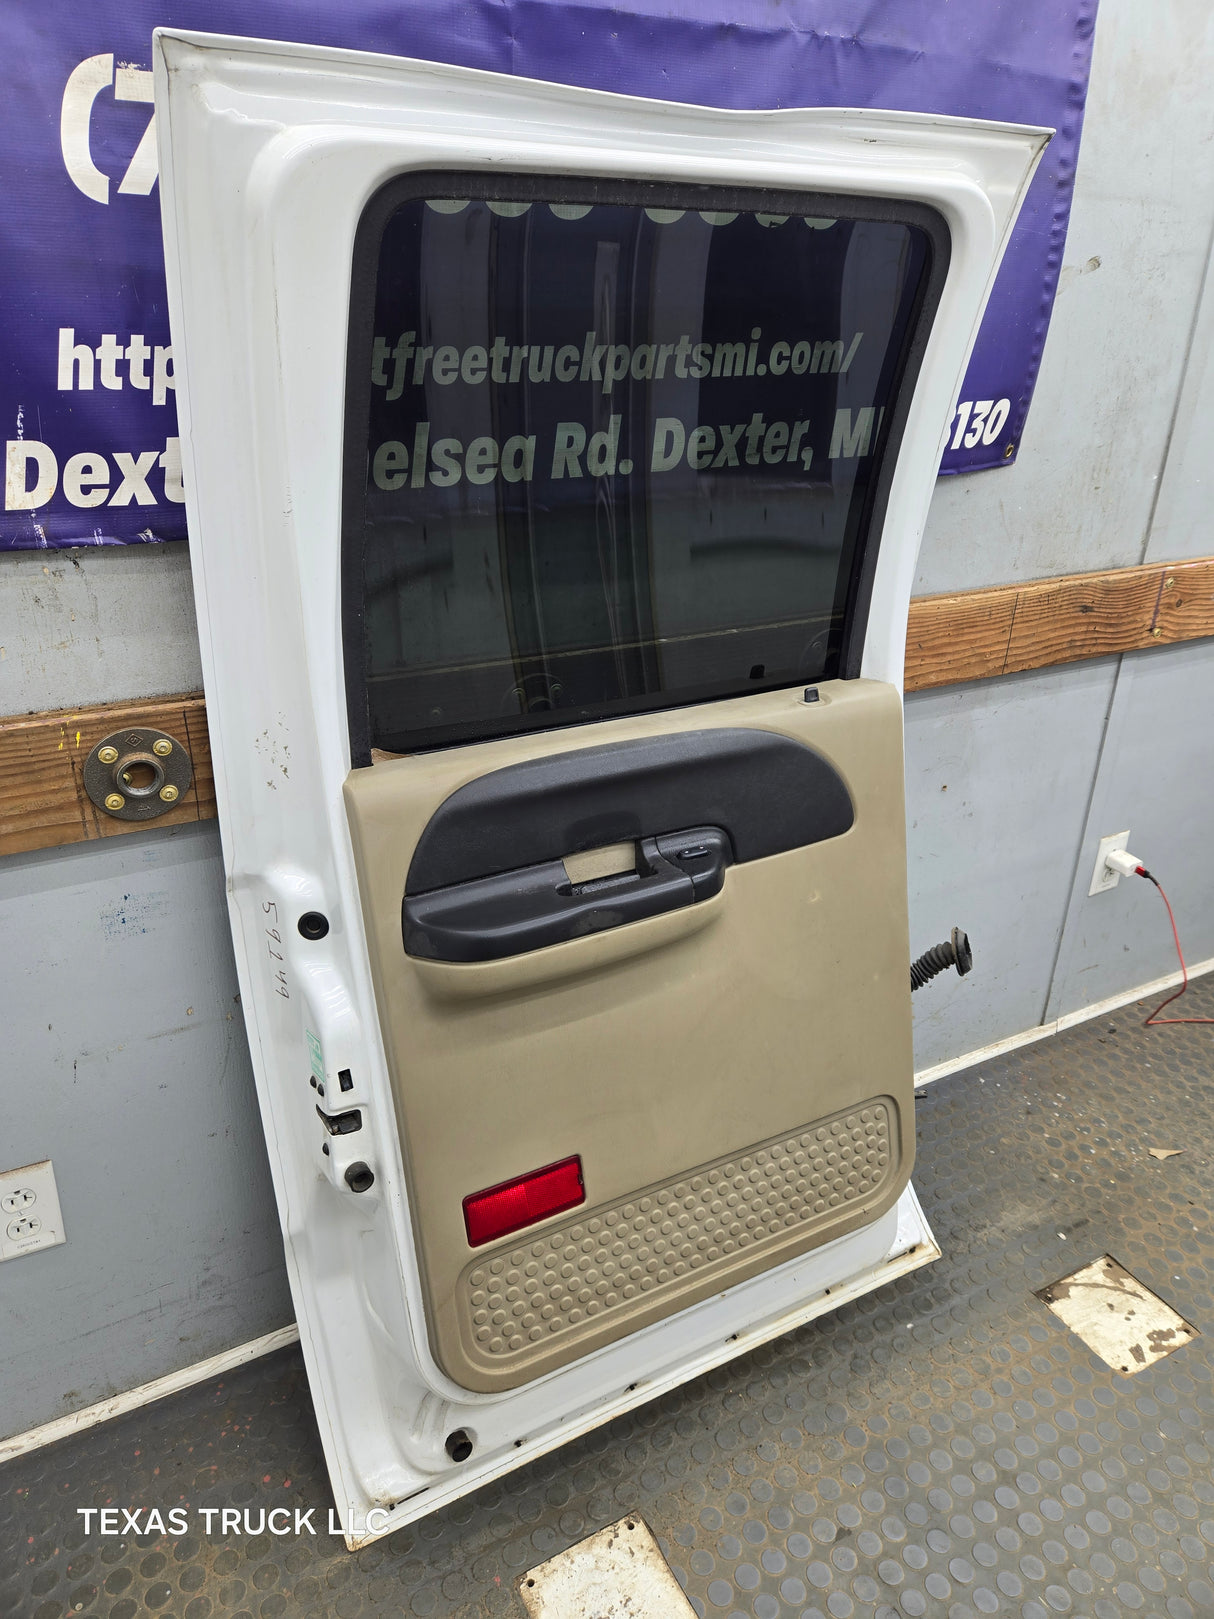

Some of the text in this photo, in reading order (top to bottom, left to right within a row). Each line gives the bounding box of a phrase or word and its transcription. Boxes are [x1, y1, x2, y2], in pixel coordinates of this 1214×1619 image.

[551, 414, 634, 479] Rd.
[650, 413, 814, 471] Dexter,
[828, 406, 885, 459] M
